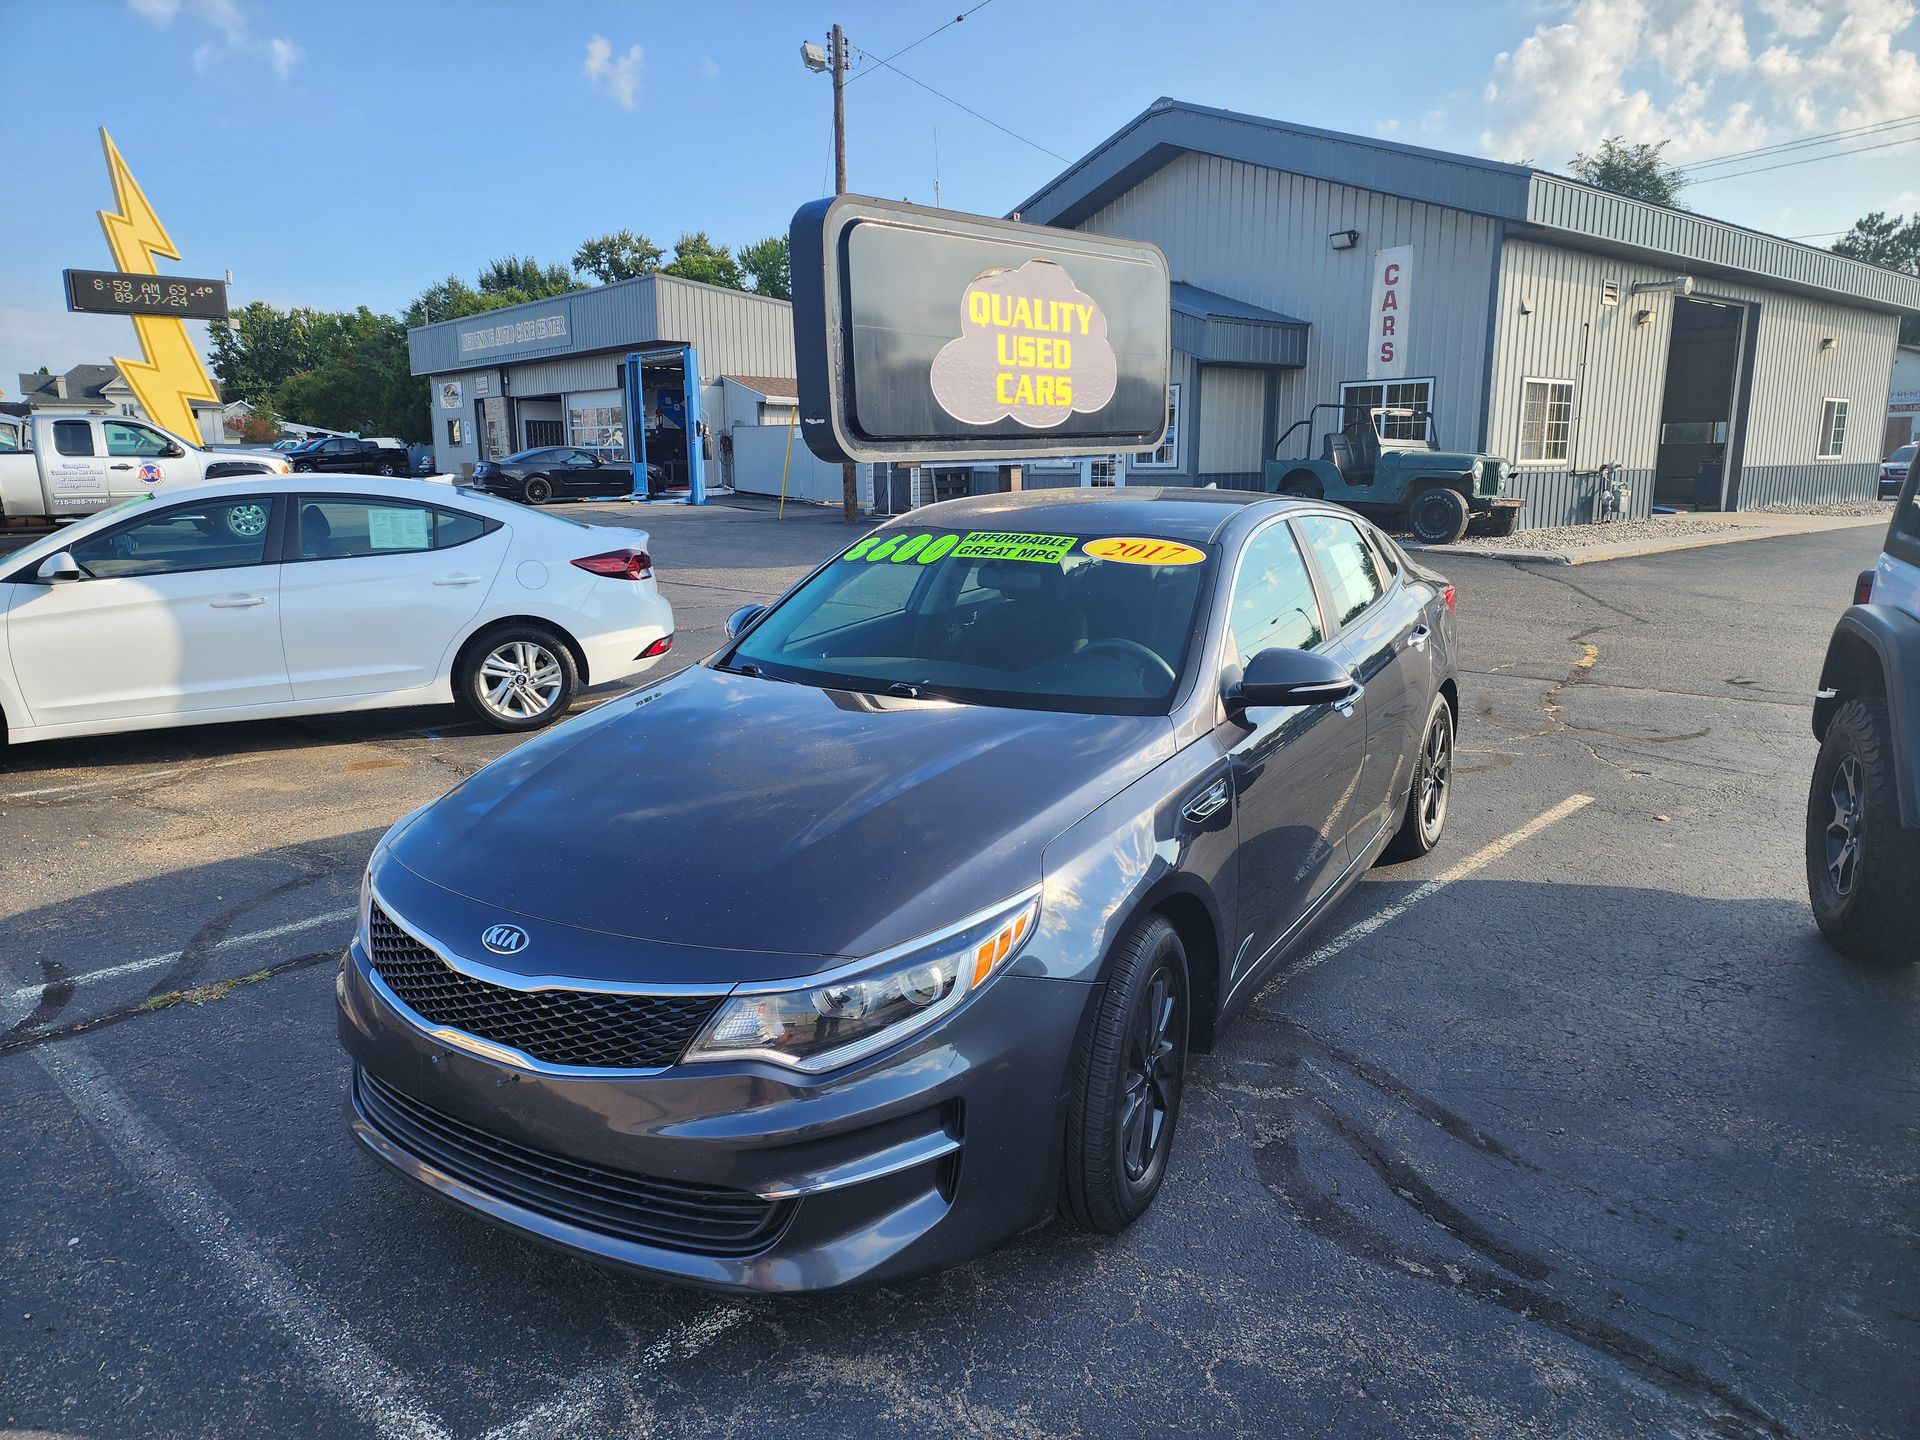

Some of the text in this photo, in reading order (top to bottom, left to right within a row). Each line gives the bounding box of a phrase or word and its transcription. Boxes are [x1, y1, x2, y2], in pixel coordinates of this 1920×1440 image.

[93, 278, 132, 292] 8:59
[141, 282, 160, 294] AM
[114, 291, 189, 307] 09/17/24
[968, 290, 1094, 336] QUALITY
[1380, 263, 1400, 363] CARS
[494, 324, 515, 346] AUTO
[515, 320, 536, 343] CARE
[536, 315, 567, 340] CENTER
[996, 333, 1072, 370] USED
[996, 373, 1073, 407] CARS
[137, 467, 164, 479] A-1
[843, 533, 961, 565] 8600
[968, 532, 1073, 547] AFFORDABLE
[1102, 542, 1187, 560] 2017
[957, 545, 1060, 561] GREAT MPG
[485, 926, 520, 950] KIA
